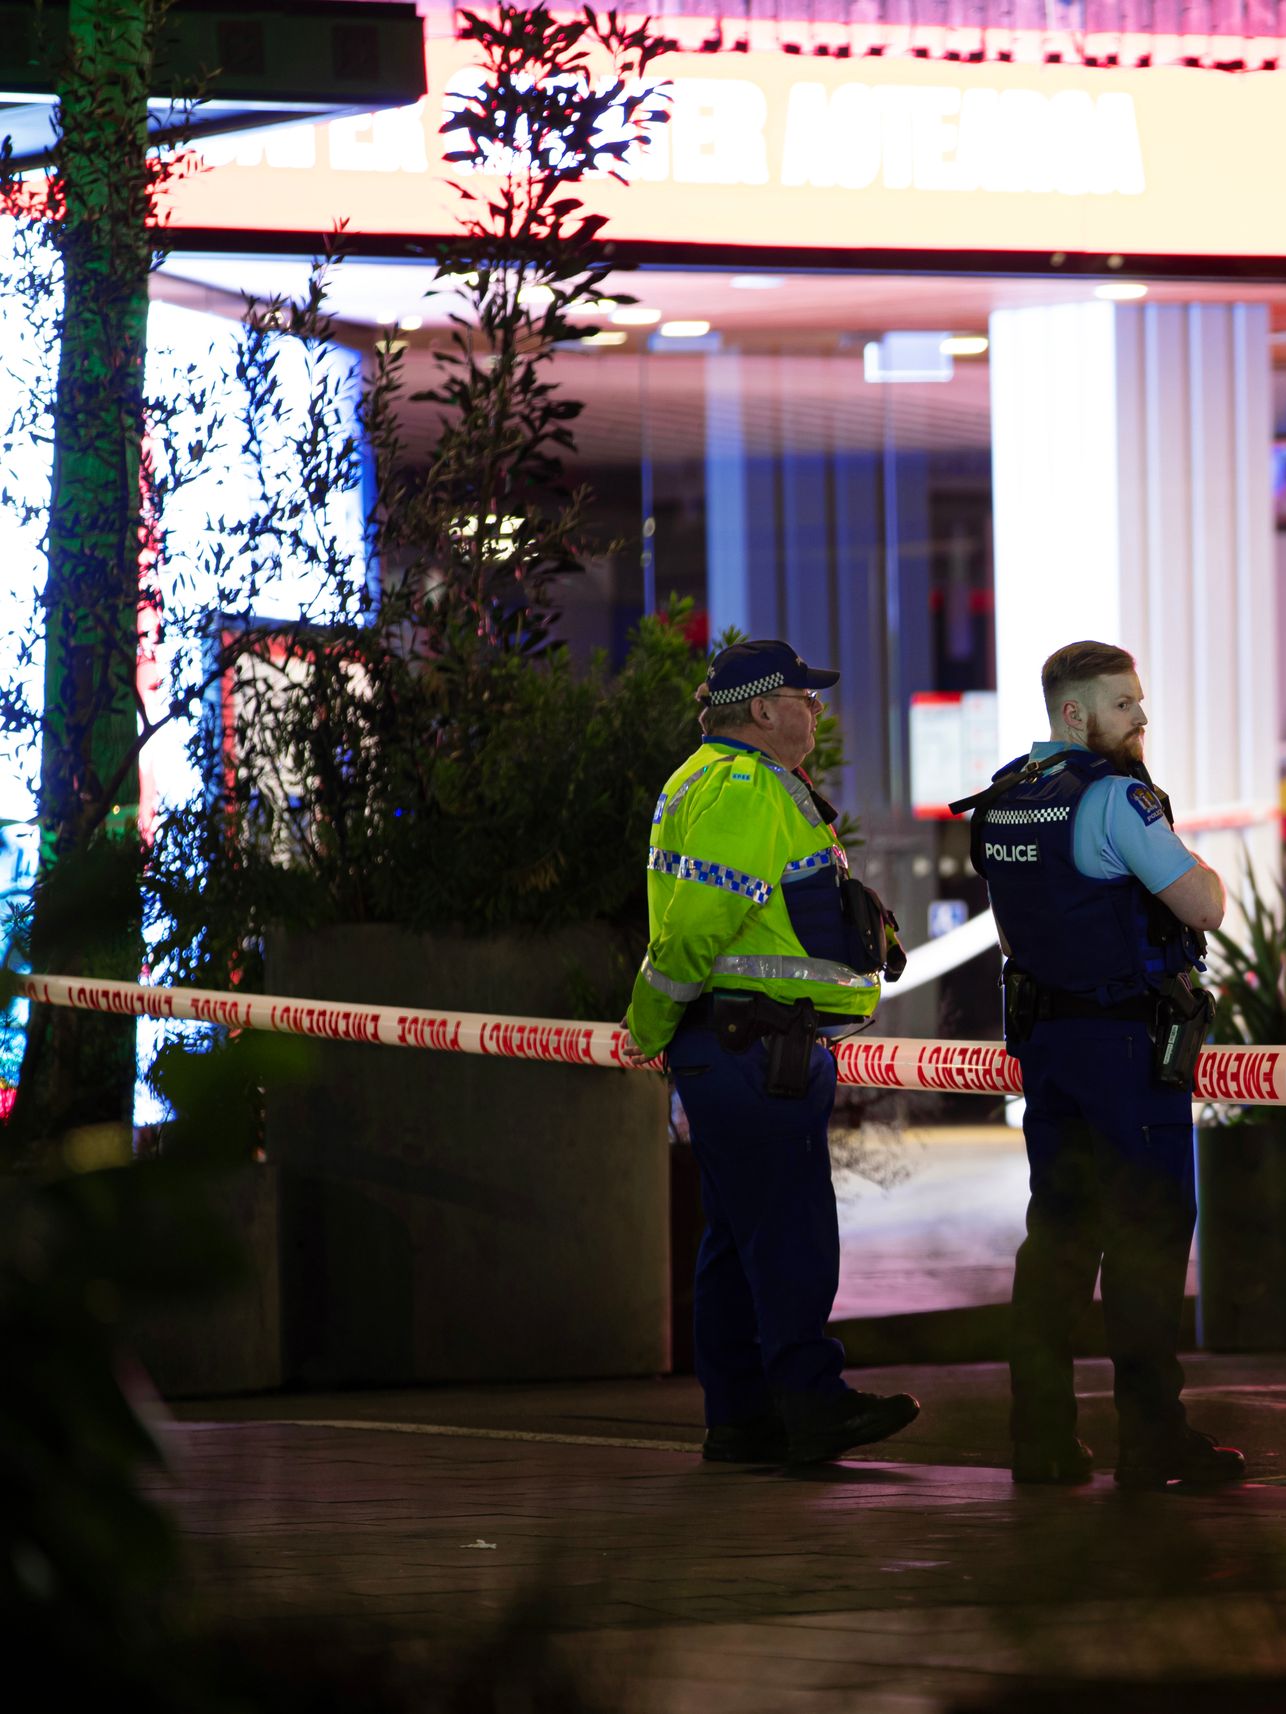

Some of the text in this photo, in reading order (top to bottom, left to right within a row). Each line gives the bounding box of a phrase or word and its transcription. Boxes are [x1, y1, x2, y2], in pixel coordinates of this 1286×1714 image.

[985, 842, 1038, 862] POLICE
[397, 1015, 463, 1053] POLICE
[479, 1022, 597, 1067] EMERGENCY
